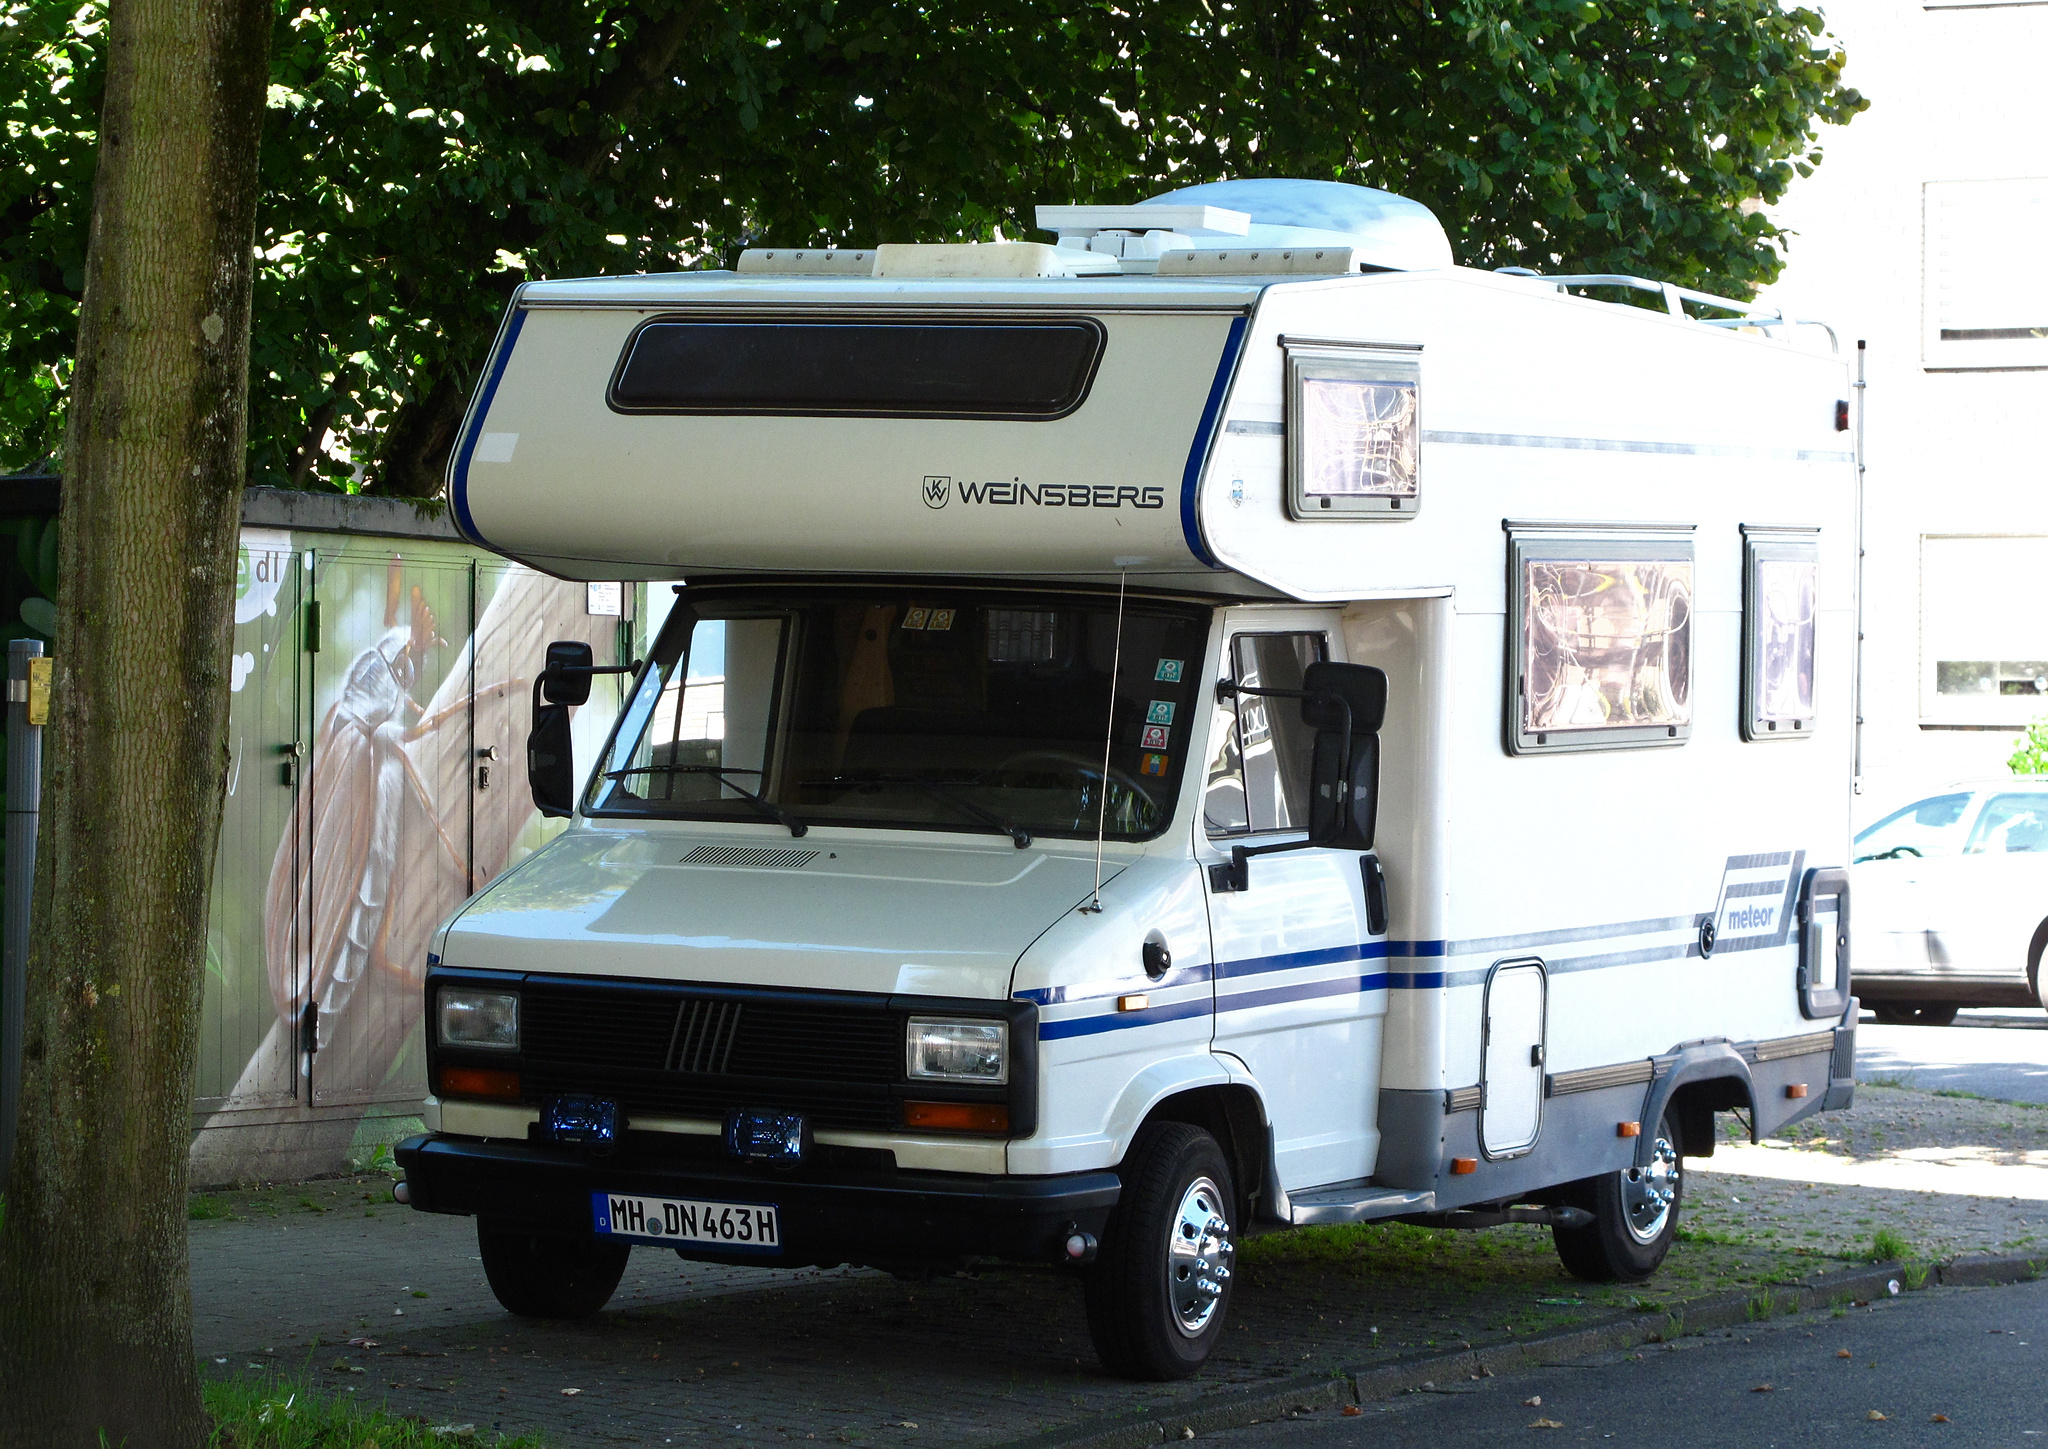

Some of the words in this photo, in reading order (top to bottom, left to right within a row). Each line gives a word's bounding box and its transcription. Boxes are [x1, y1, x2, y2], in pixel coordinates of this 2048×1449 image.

[1729, 905, 1774, 930] meteor
[599, 1217, 607, 1227] D
[611, 1198, 646, 1232] MH
